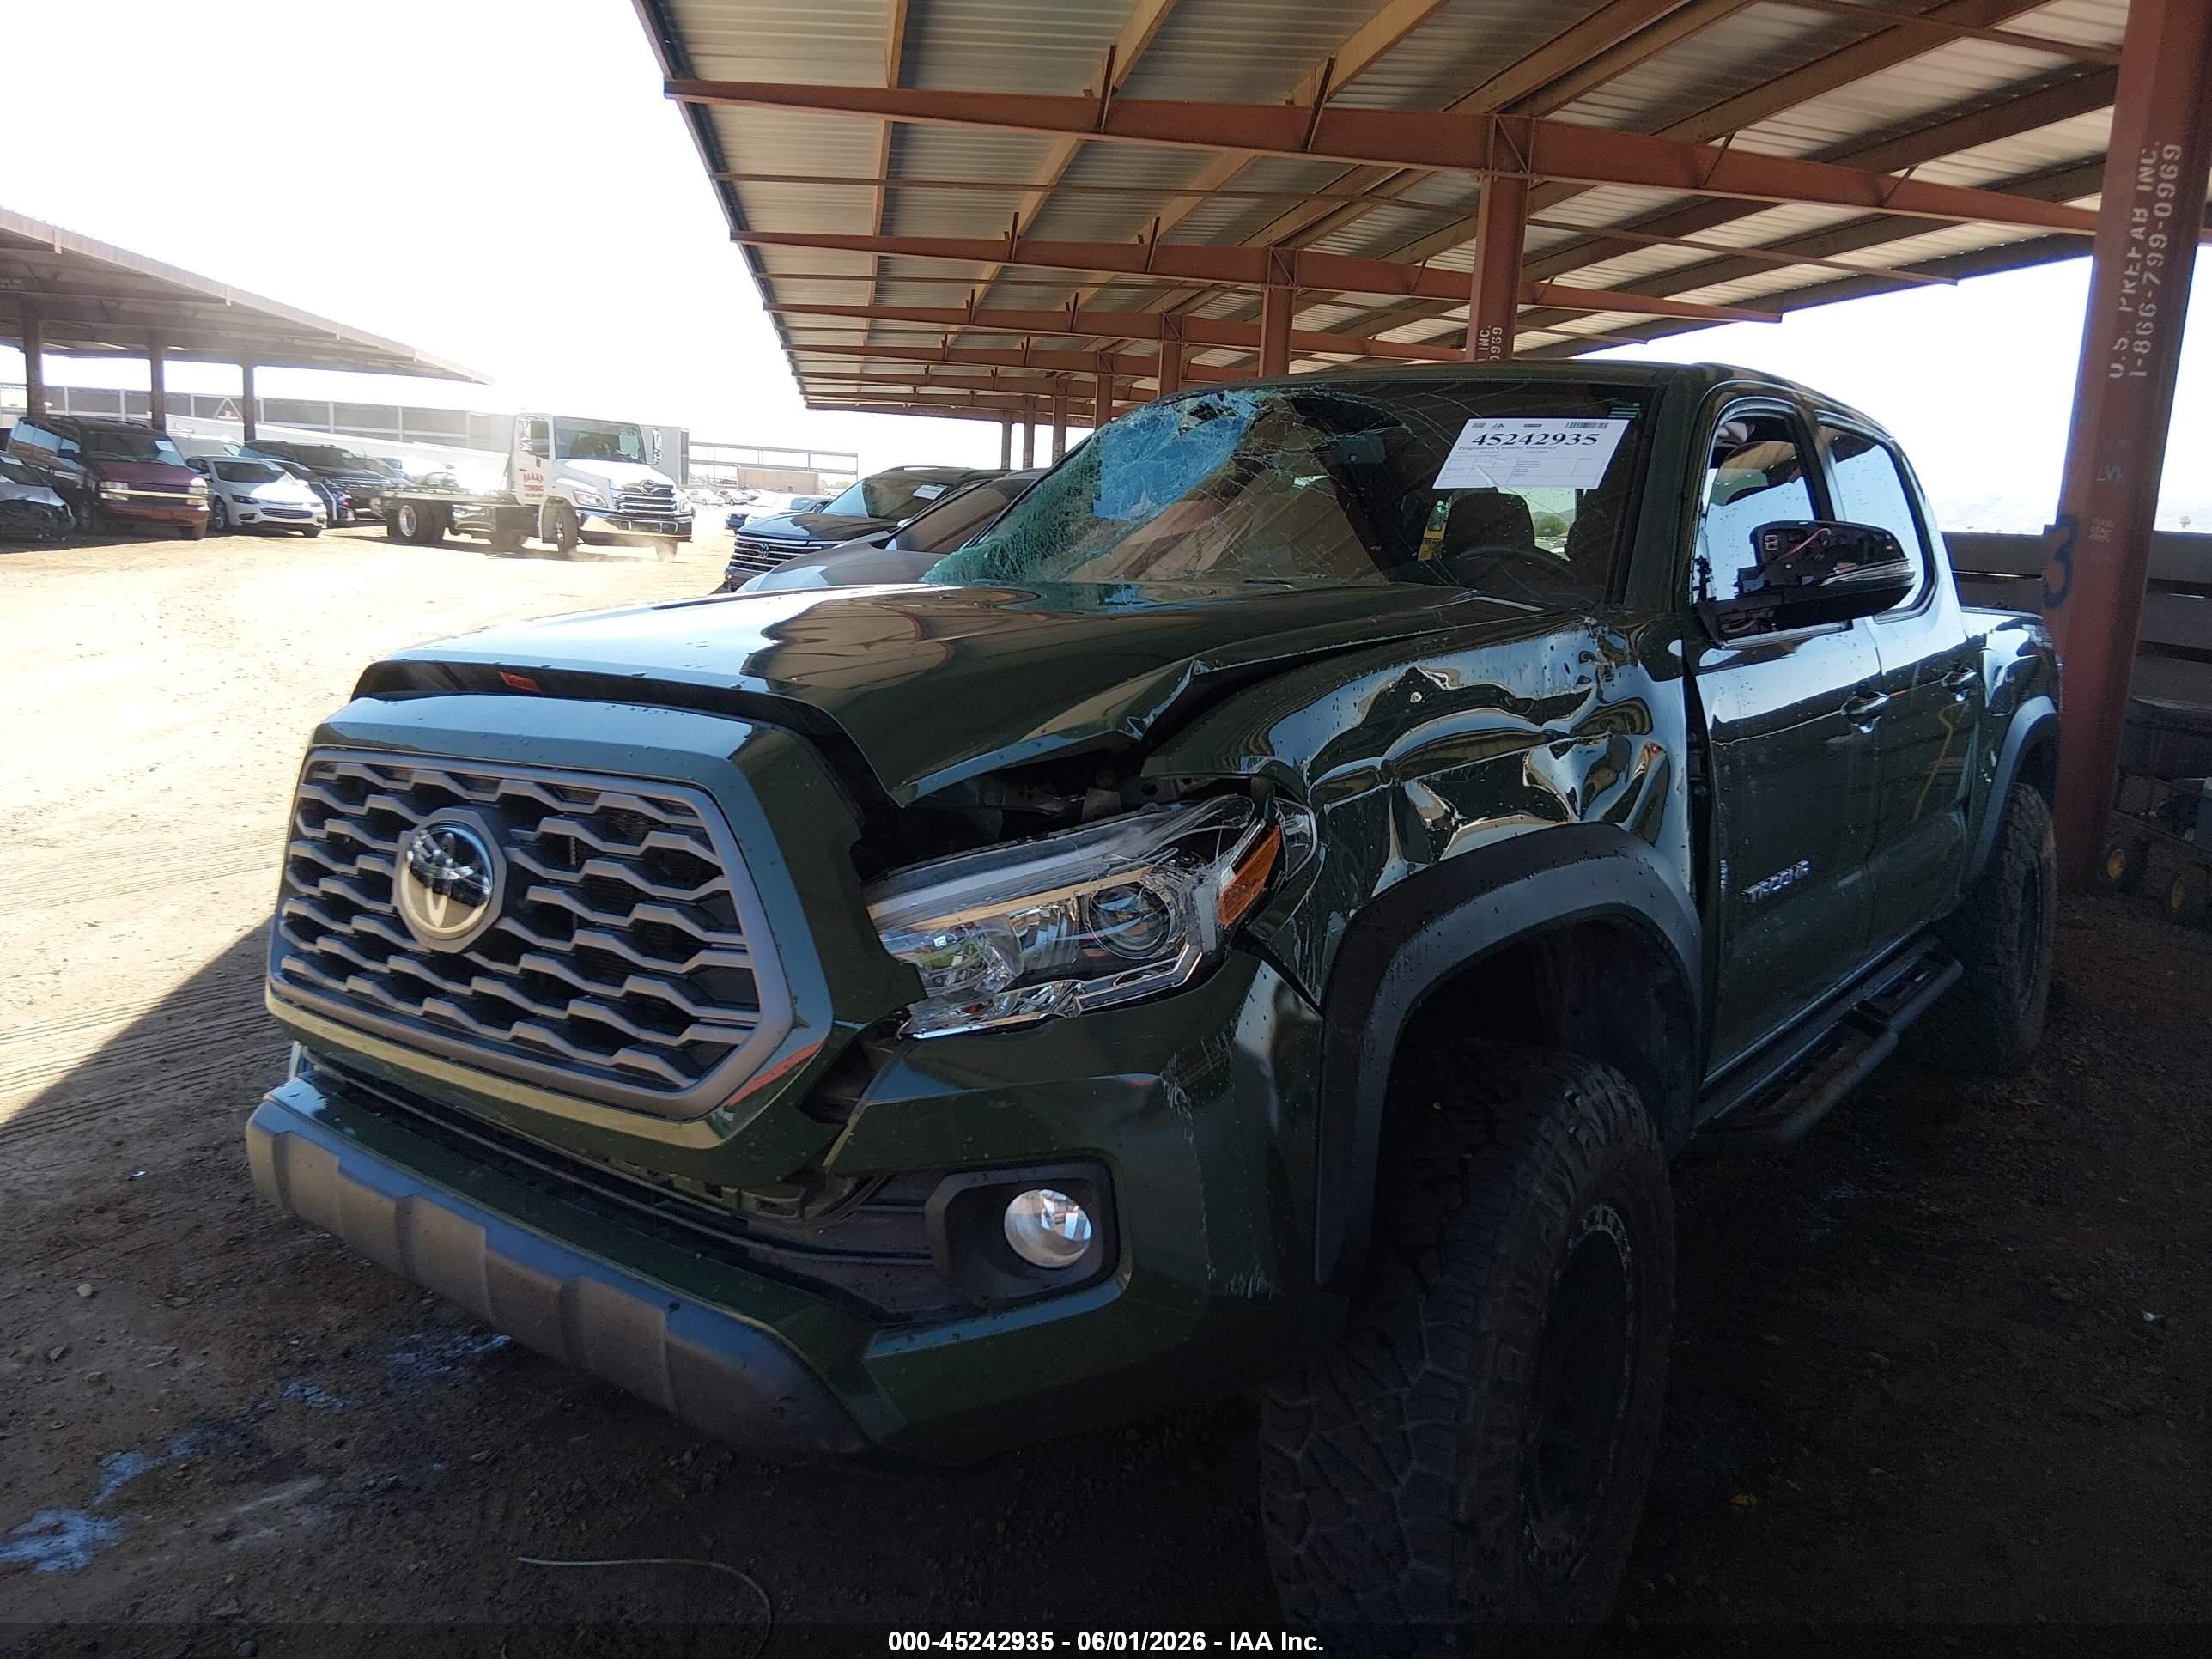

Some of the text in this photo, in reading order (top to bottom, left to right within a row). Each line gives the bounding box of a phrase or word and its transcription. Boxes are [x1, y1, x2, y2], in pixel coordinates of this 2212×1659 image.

[2108, 140, 2160, 378] U.S. PREFAB INC.
[2128, 143, 2183, 379] 1-866-799-0969
[1478, 325, 1492, 351] INC.
[1472, 432, 1601, 446] 45242935
